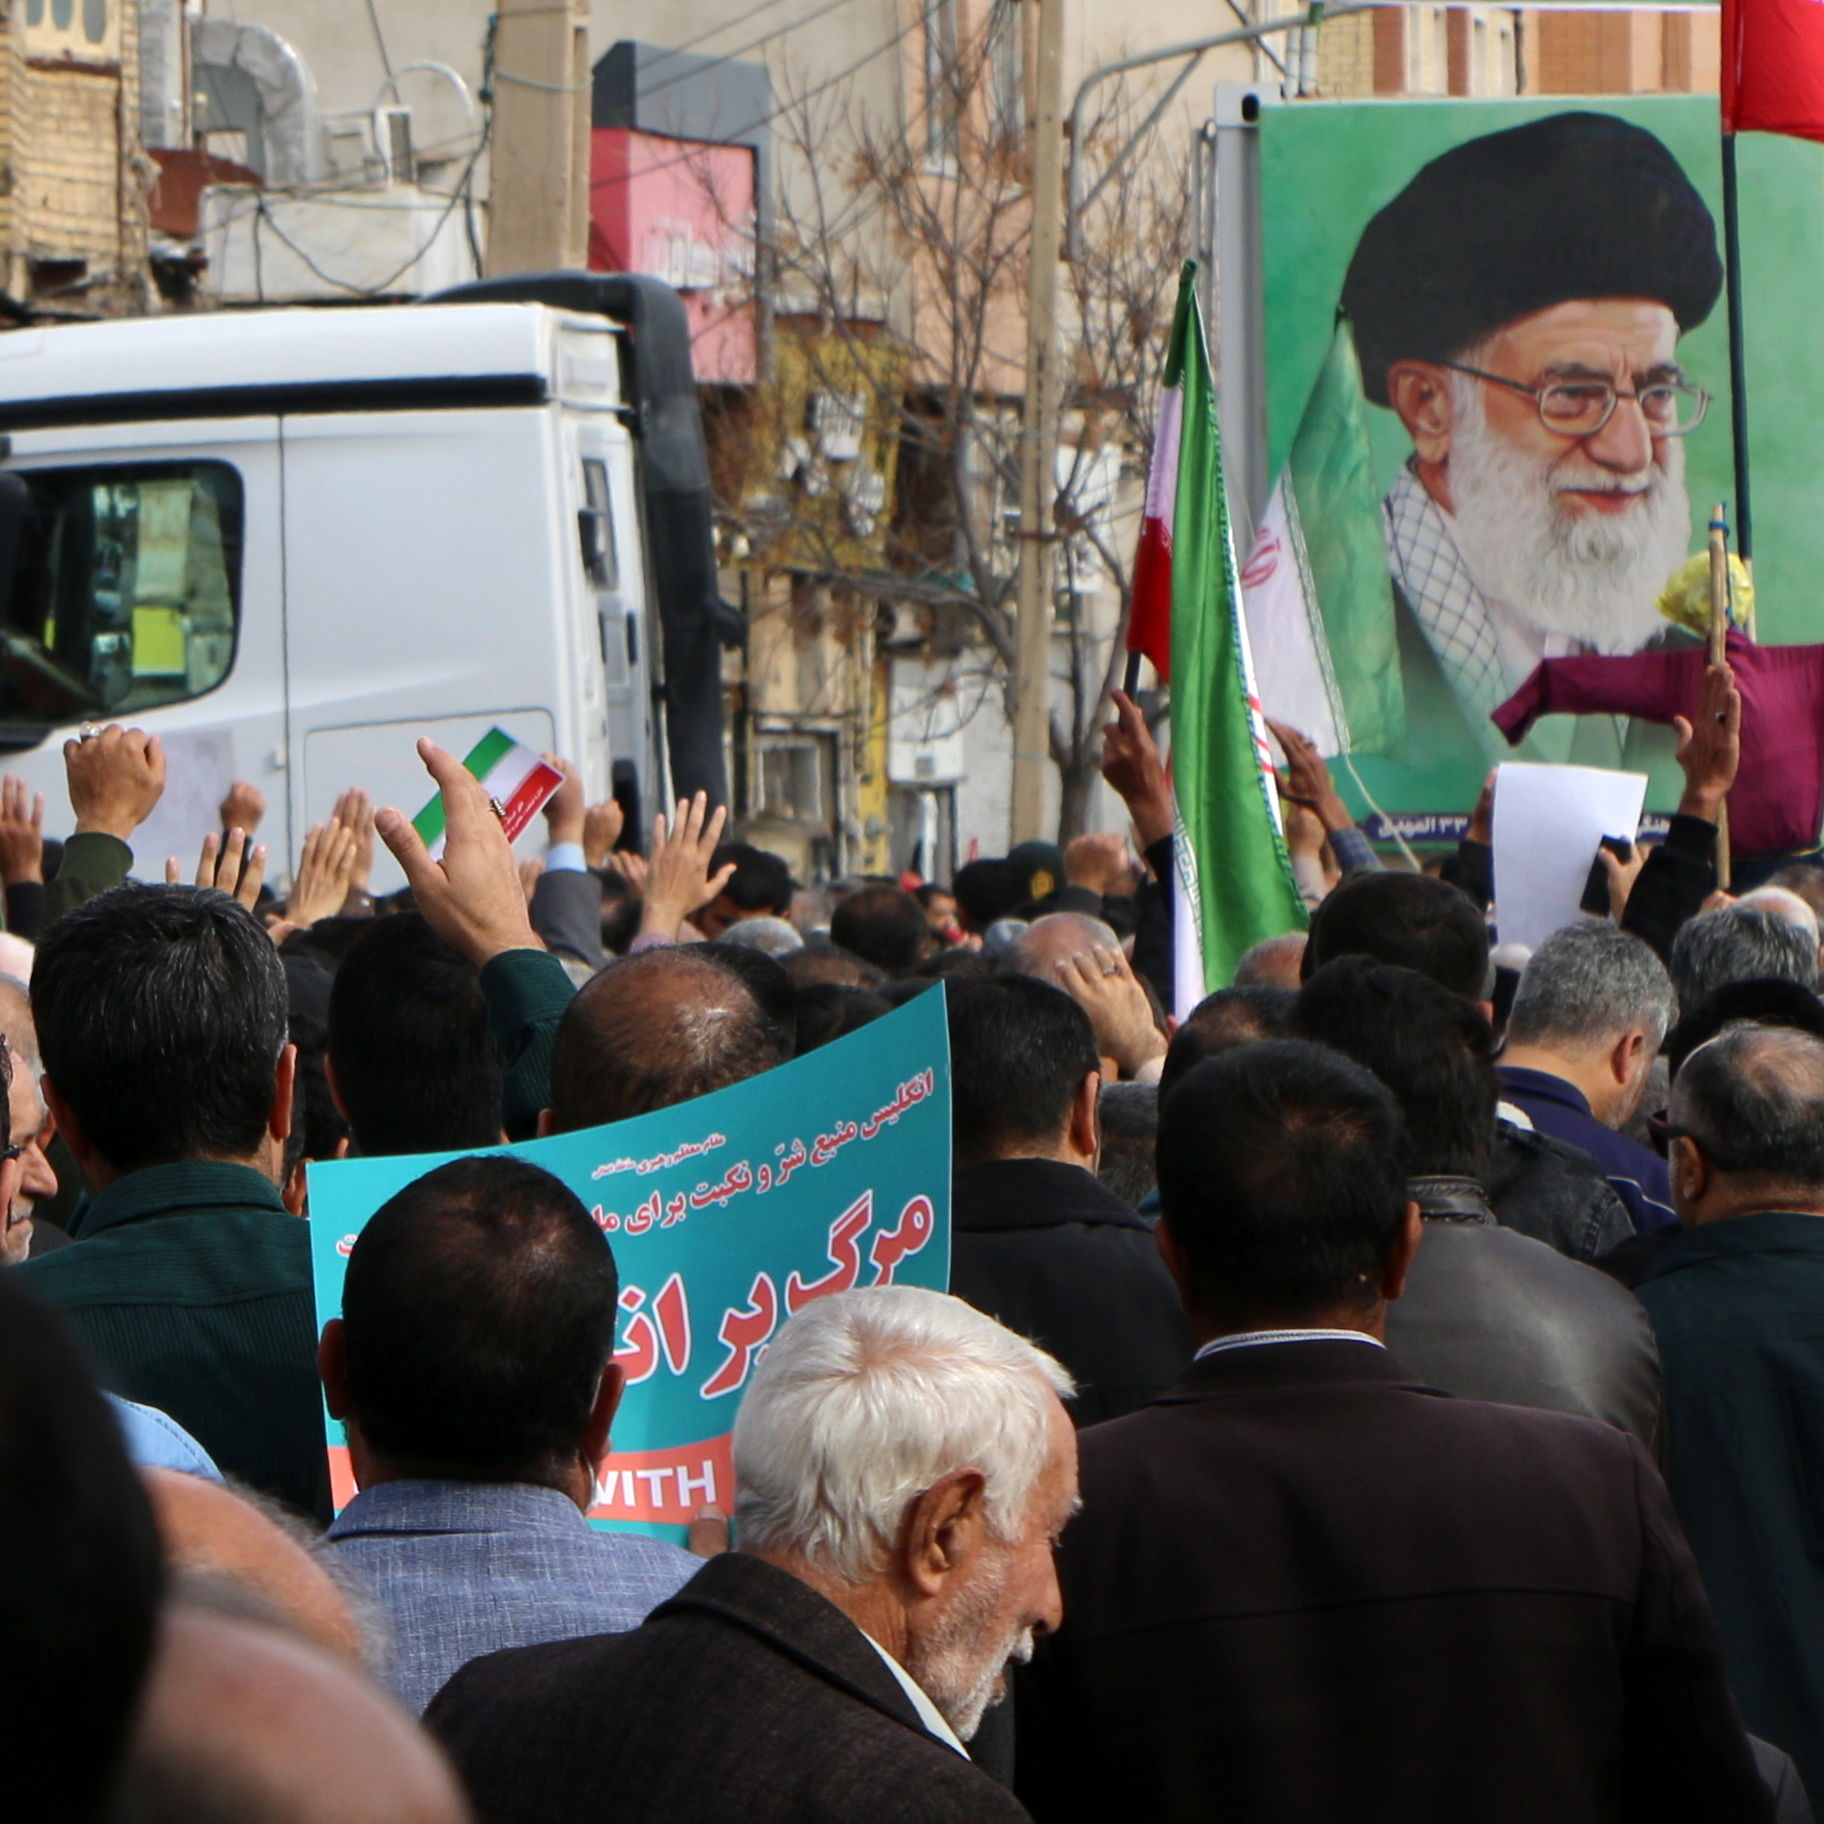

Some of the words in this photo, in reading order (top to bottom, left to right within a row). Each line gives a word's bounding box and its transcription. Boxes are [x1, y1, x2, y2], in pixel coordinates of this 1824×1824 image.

[809, 1120, 859, 1165] منبع
[689, 1161, 753, 1208] نکبت
[756, 1164, 772, 1194] و
[624, 1190, 686, 1235] برای
[785, 1187, 936, 1313] مرگ
